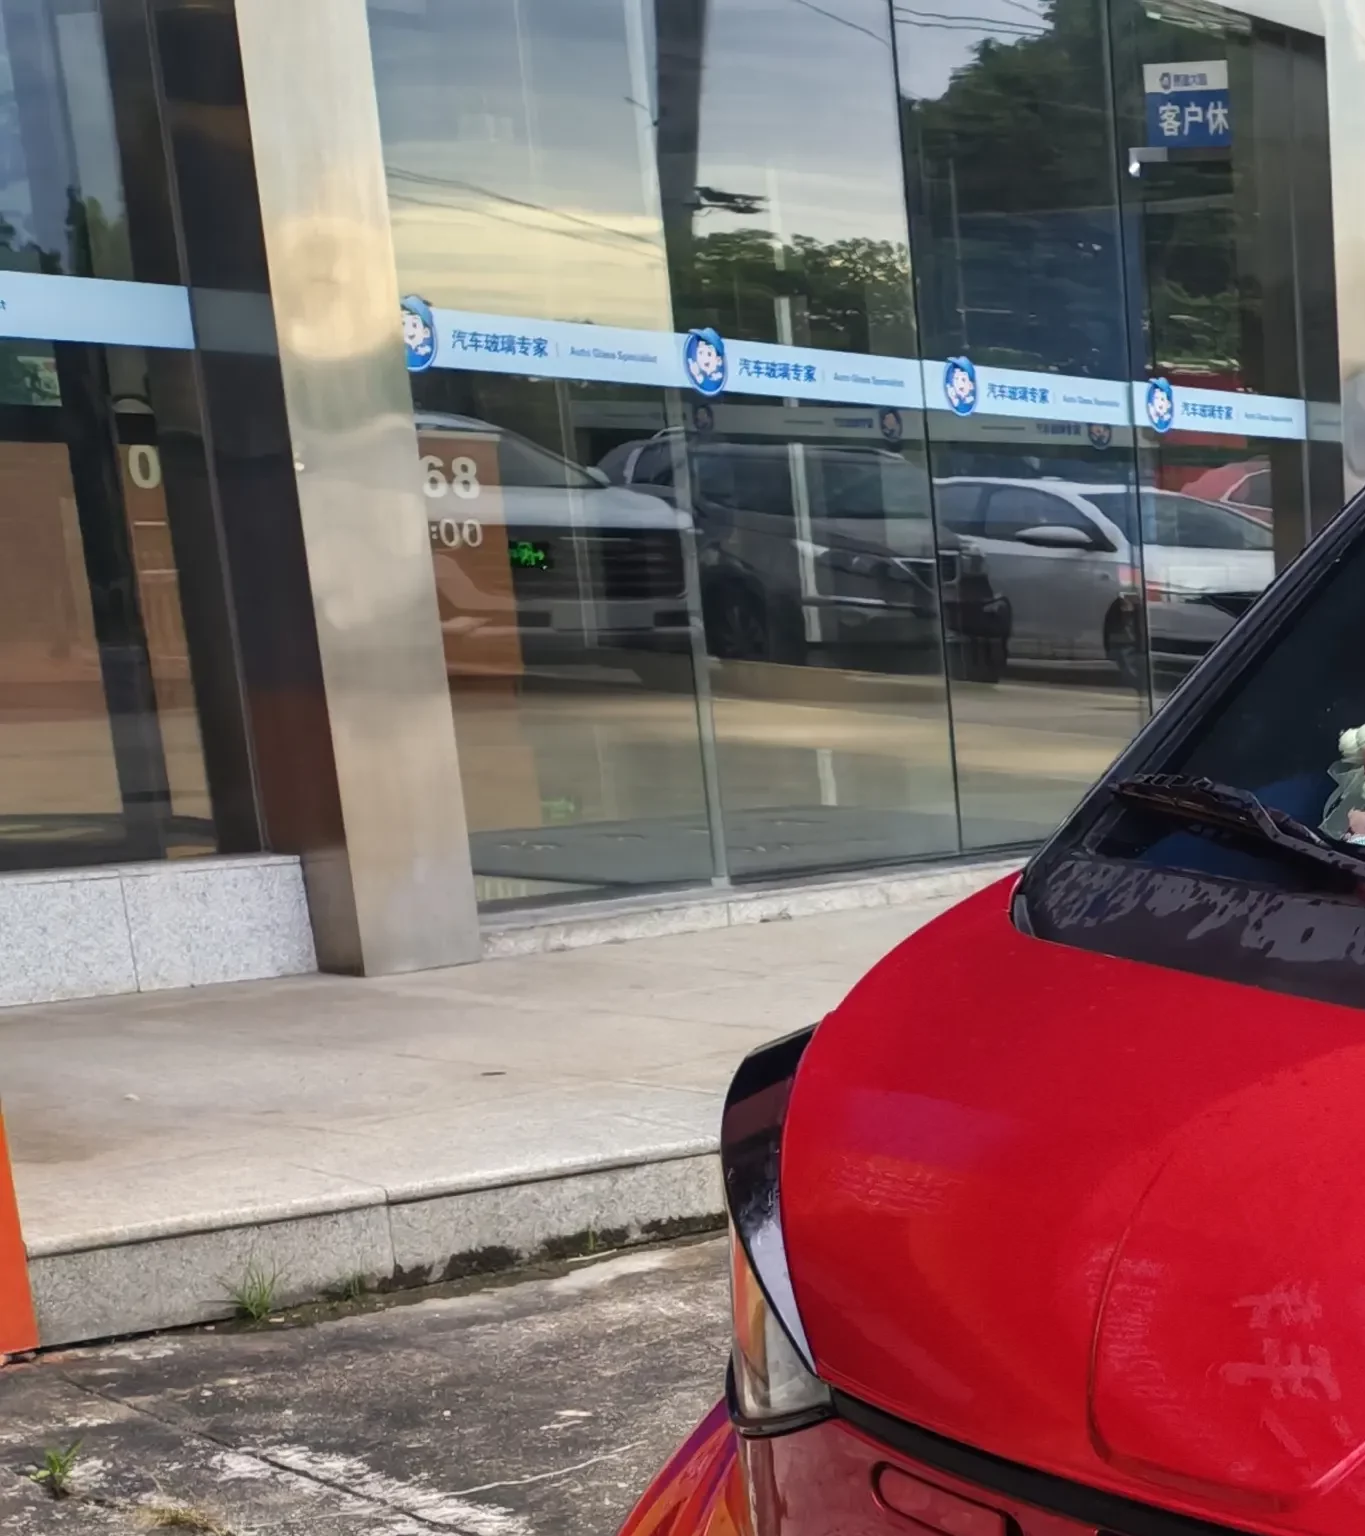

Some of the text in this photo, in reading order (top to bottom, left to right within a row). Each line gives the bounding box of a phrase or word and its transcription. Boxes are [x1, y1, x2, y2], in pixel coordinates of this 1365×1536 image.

[1158, 101, 1229, 136] 客户休
[451, 329, 549, 358] 汽车玻璃专家
[738, 358, 816, 383] 汽车玻璃专家
[420, 455, 481, 499] 68
